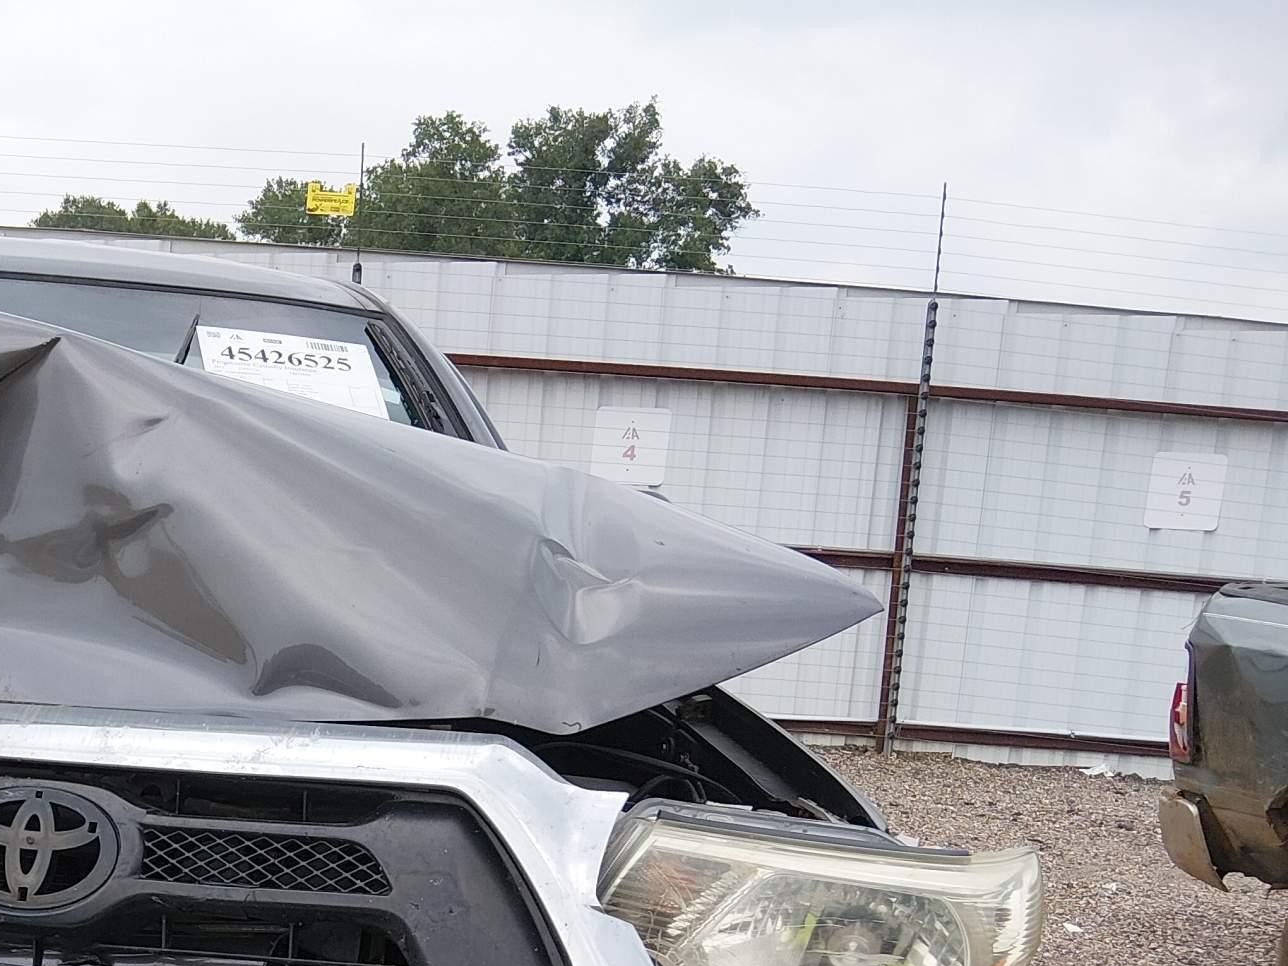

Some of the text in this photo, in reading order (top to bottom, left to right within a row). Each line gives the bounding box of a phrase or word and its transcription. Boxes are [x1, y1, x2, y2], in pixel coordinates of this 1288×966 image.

[220, 345, 352, 371] 45426525
[622, 444, 636, 460] 4
[1177, 490, 1192, 506] 5
